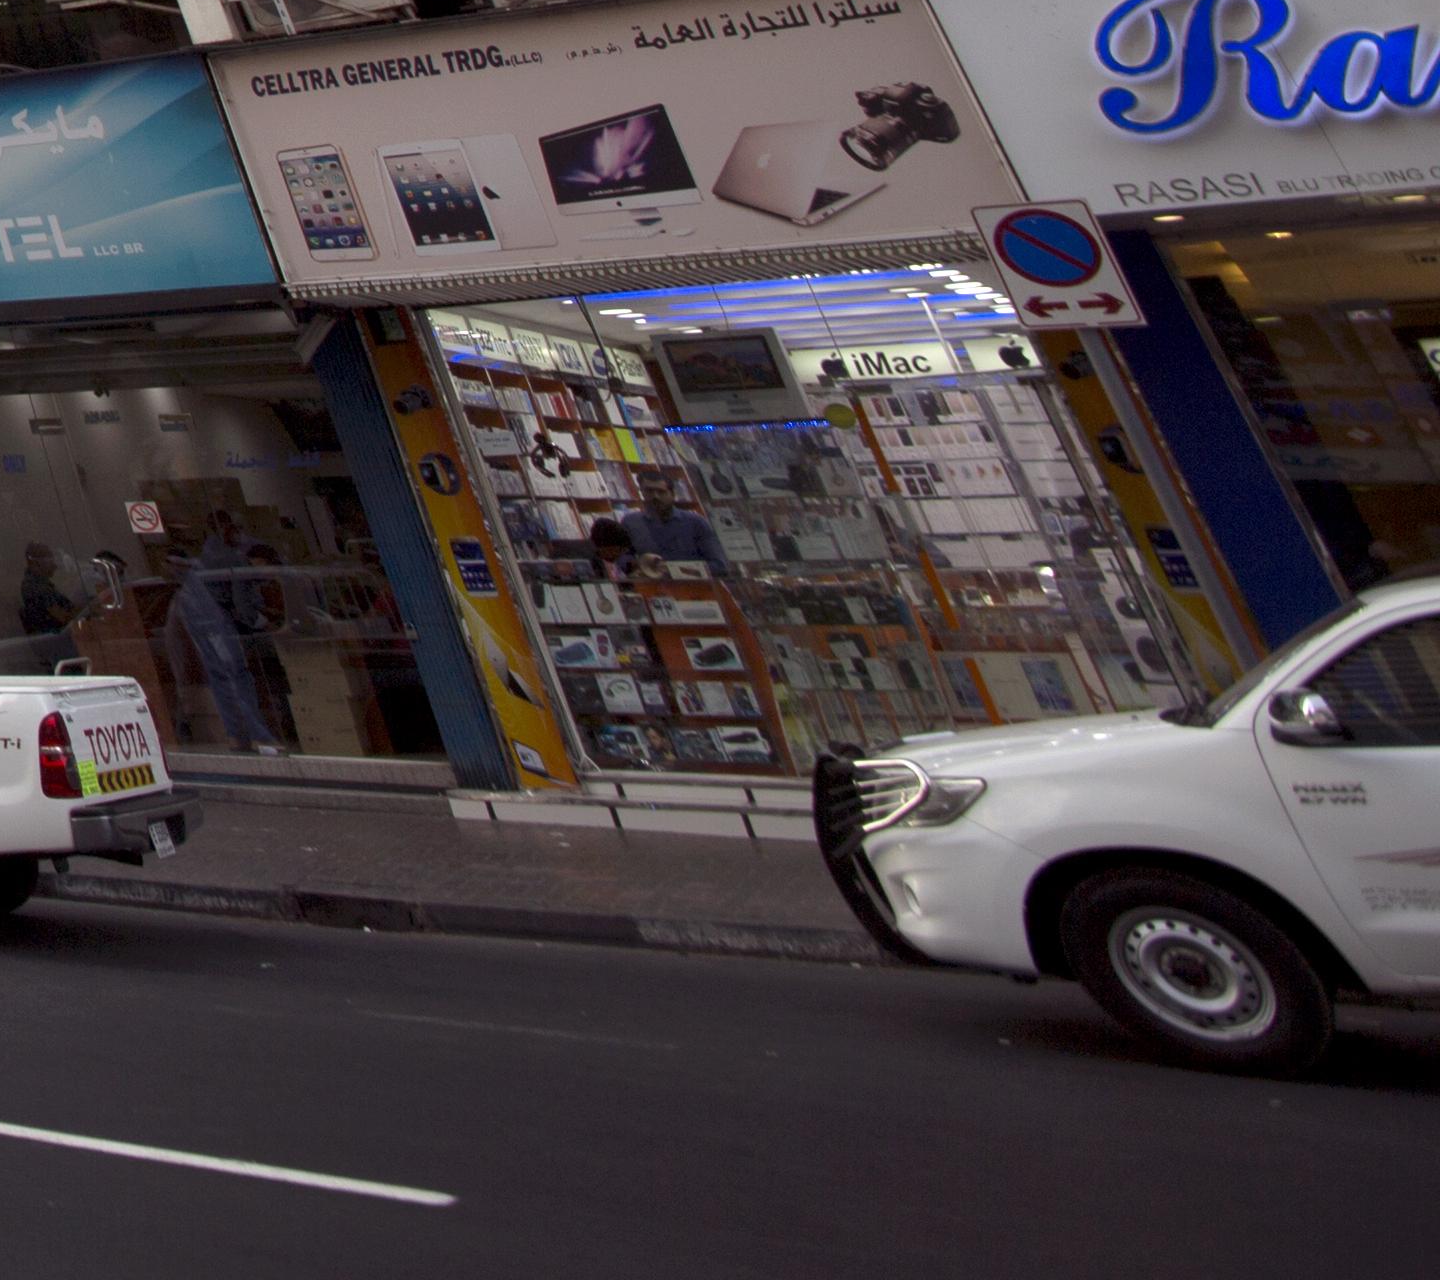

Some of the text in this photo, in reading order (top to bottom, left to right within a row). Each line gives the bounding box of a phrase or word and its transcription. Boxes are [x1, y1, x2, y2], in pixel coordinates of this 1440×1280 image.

[634, 17, 714, 50] العامة
[722, 4, 809, 41] للتجارة
[252, 66, 340, 97] CELLTRA
[342, 53, 440, 86] GENERAL
[1114, 172, 1266, 207] RASASI
[1277, 178, 1319, 194] BLU
[1329, 167, 1424, 190] TRADING
[93, 243, 119, 257] LLC
[123, 242, 144, 255] BR
[852, 351, 932, 376] iMac
[3, 453, 27, 474] ONLY
[84, 722, 151, 765] TOYOTA
